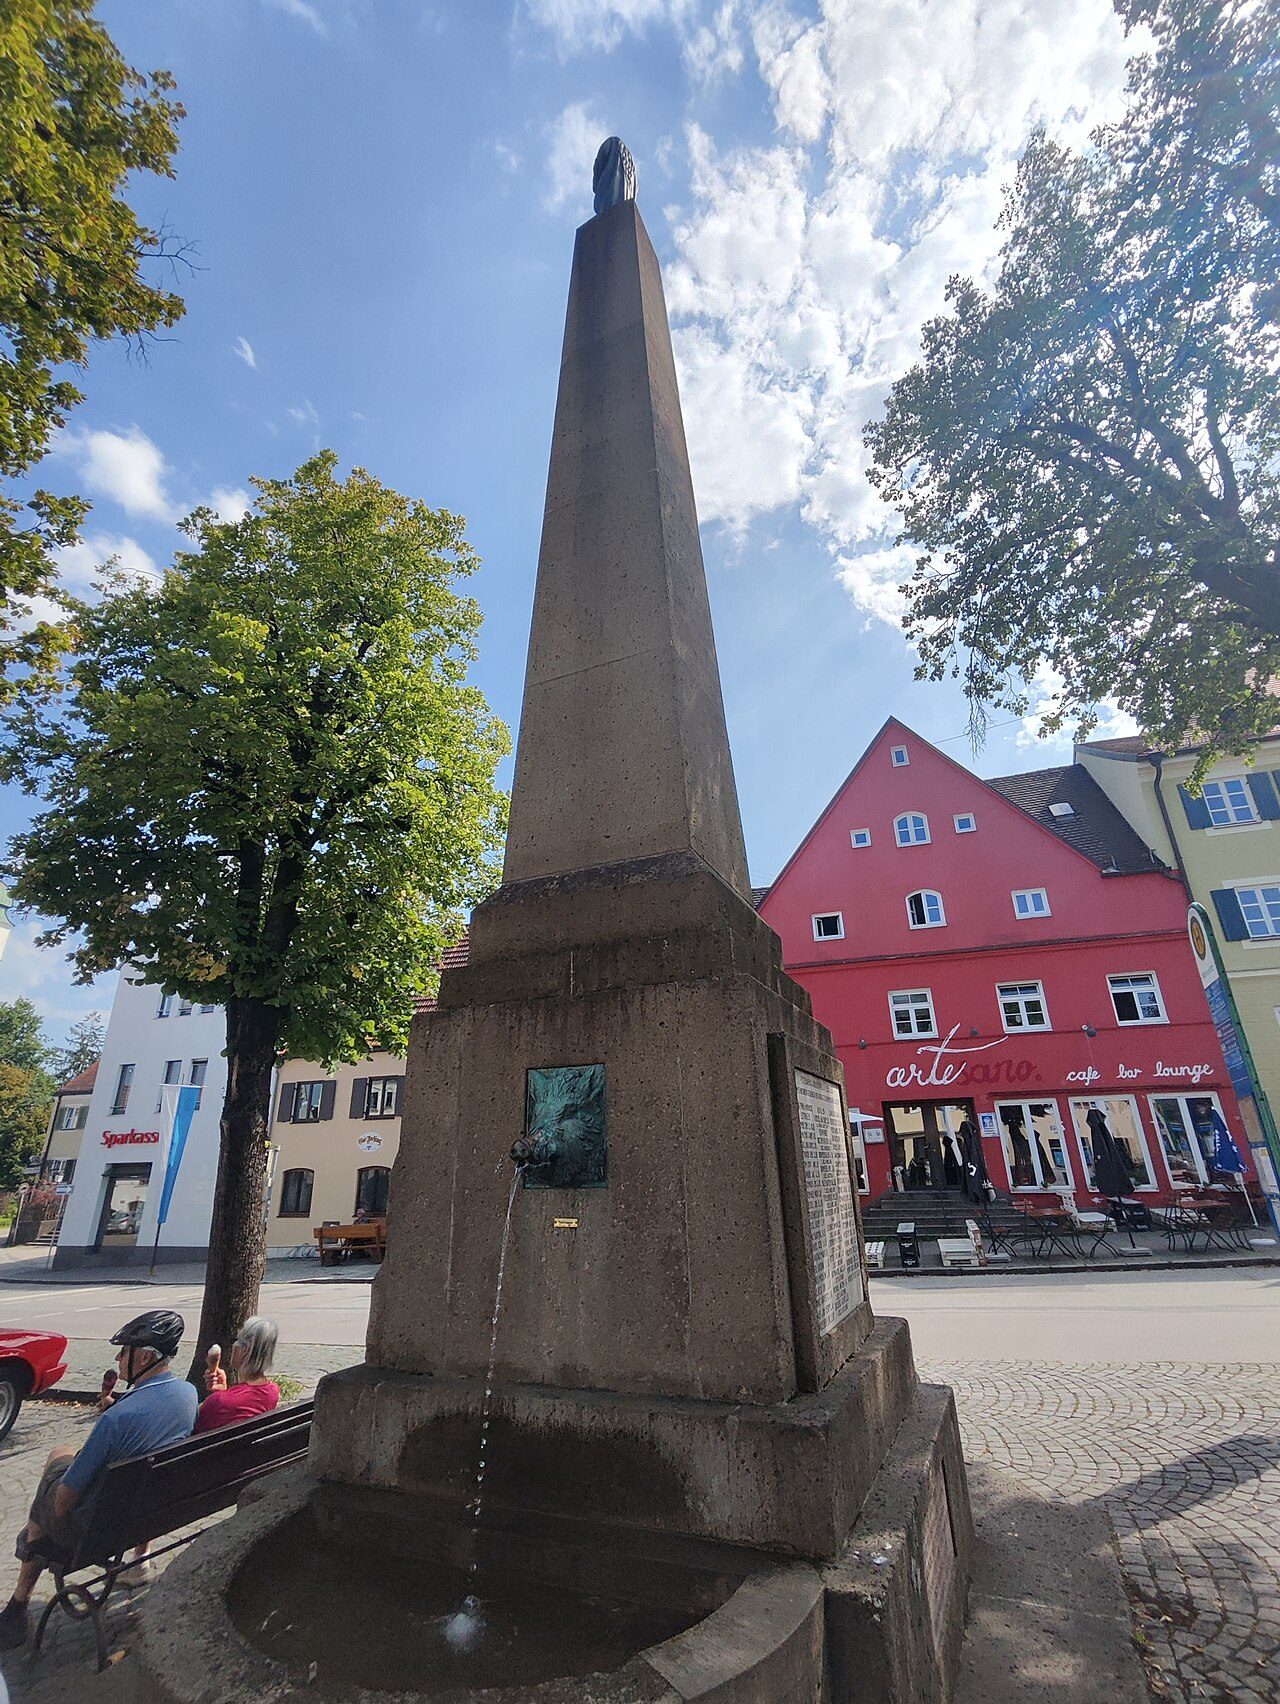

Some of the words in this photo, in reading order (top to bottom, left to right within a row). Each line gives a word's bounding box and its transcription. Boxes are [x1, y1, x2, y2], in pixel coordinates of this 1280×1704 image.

[1066, 1066, 1101, 1086] cafe
[1116, 1063, 1142, 1079] bar
[1153, 1060, 1214, 1084] lounge
[100, 1128, 160, 1148] Sparkass
